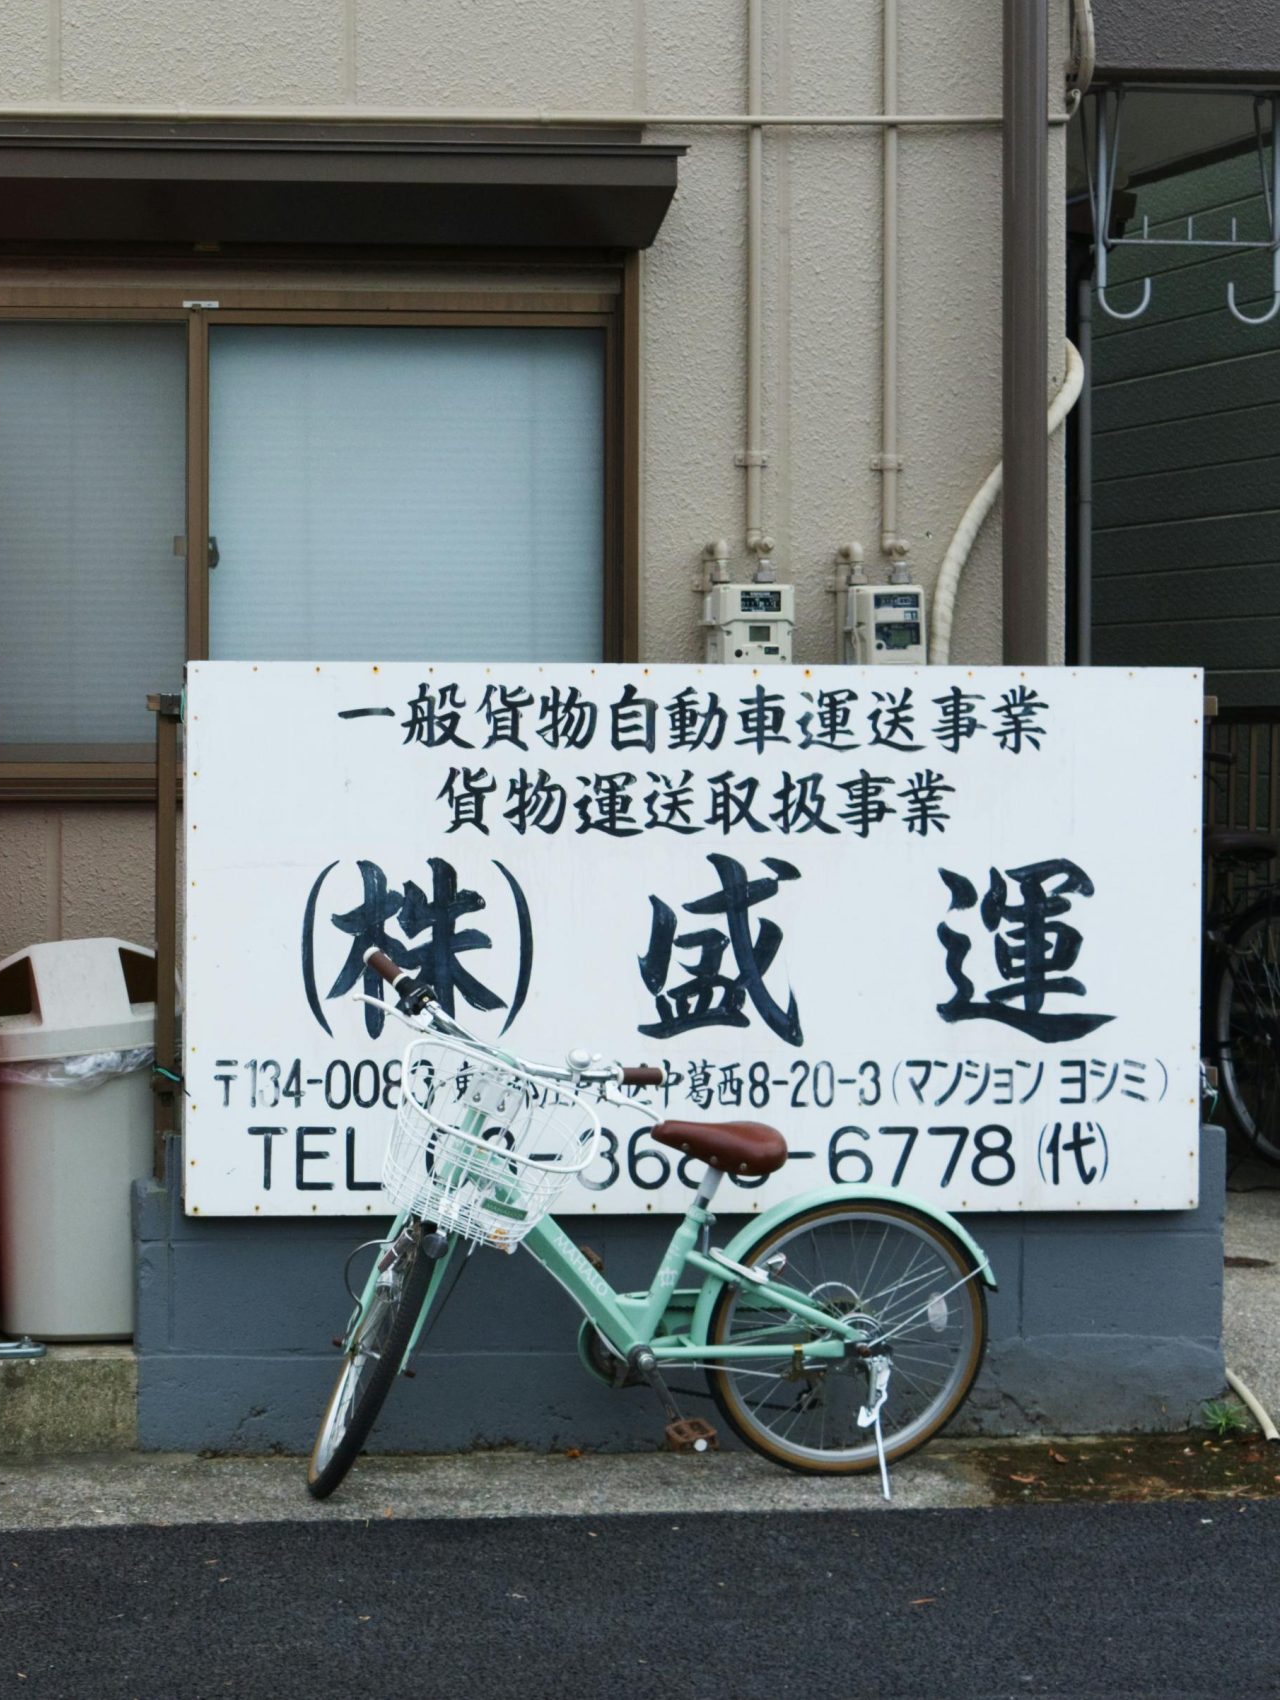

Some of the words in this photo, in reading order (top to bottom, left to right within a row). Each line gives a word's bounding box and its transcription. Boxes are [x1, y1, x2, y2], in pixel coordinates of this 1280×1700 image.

[337, 682, 1050, 754] 一般貨物自動車運送事業
[436, 766, 957, 838] 貨物運送取扱事業
[247, 1125, 385, 1191] TEL
[553, 1232, 609, 1297] MAHALO
